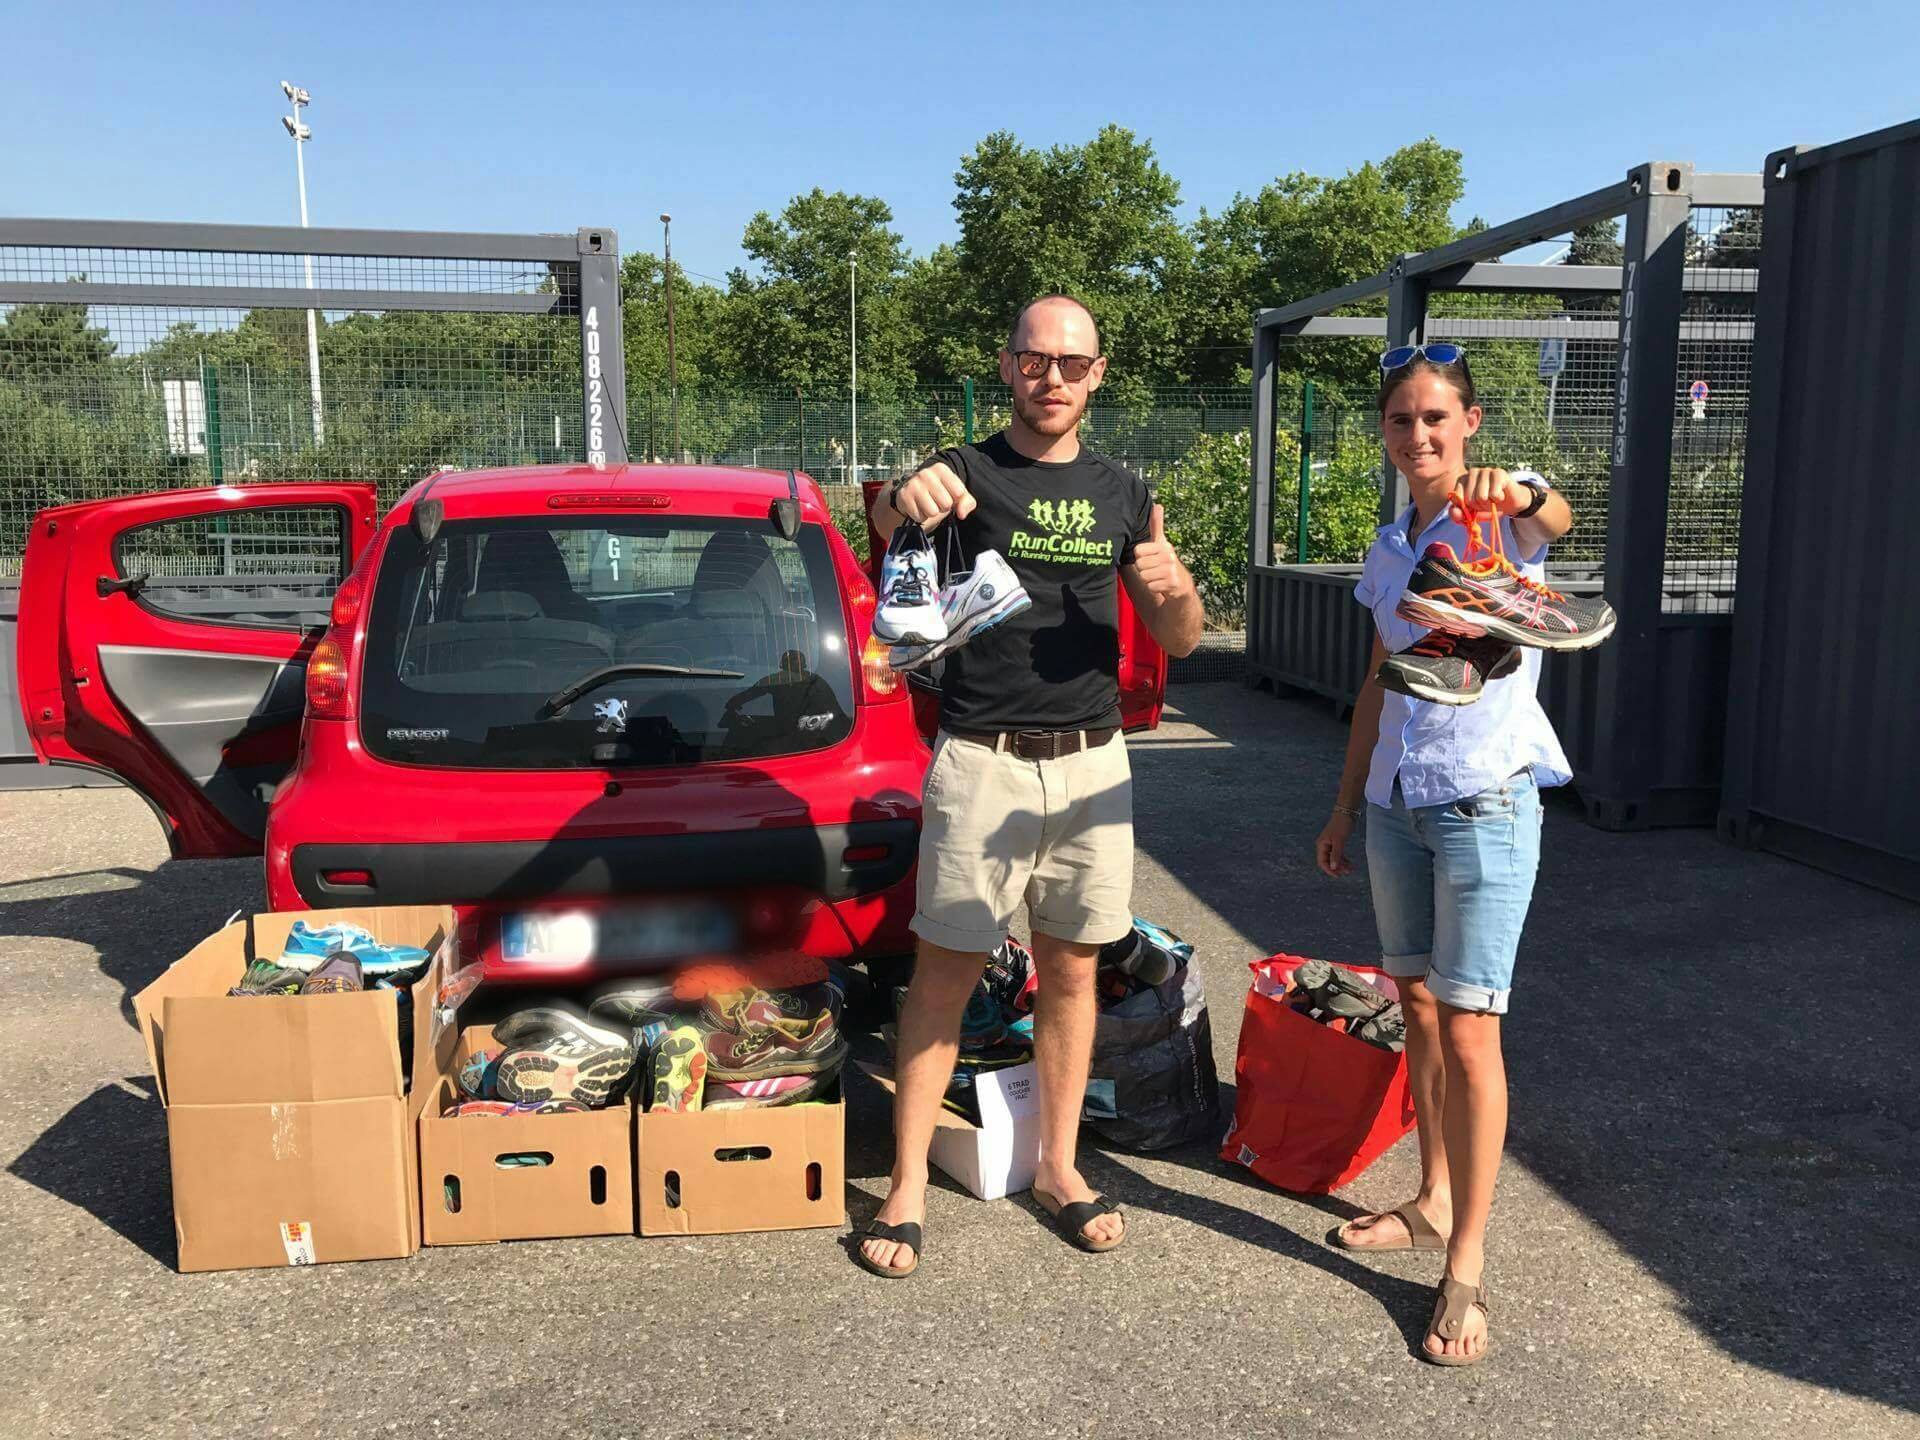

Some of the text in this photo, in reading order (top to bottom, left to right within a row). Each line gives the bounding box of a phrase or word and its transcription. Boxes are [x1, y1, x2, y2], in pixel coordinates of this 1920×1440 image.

[1010, 531, 1113, 557] RunCollect
[1008, 548, 1019, 558] Le
[1020, 549, 1051, 562] Running
[386, 729, 449, 741] PEUGEOT
